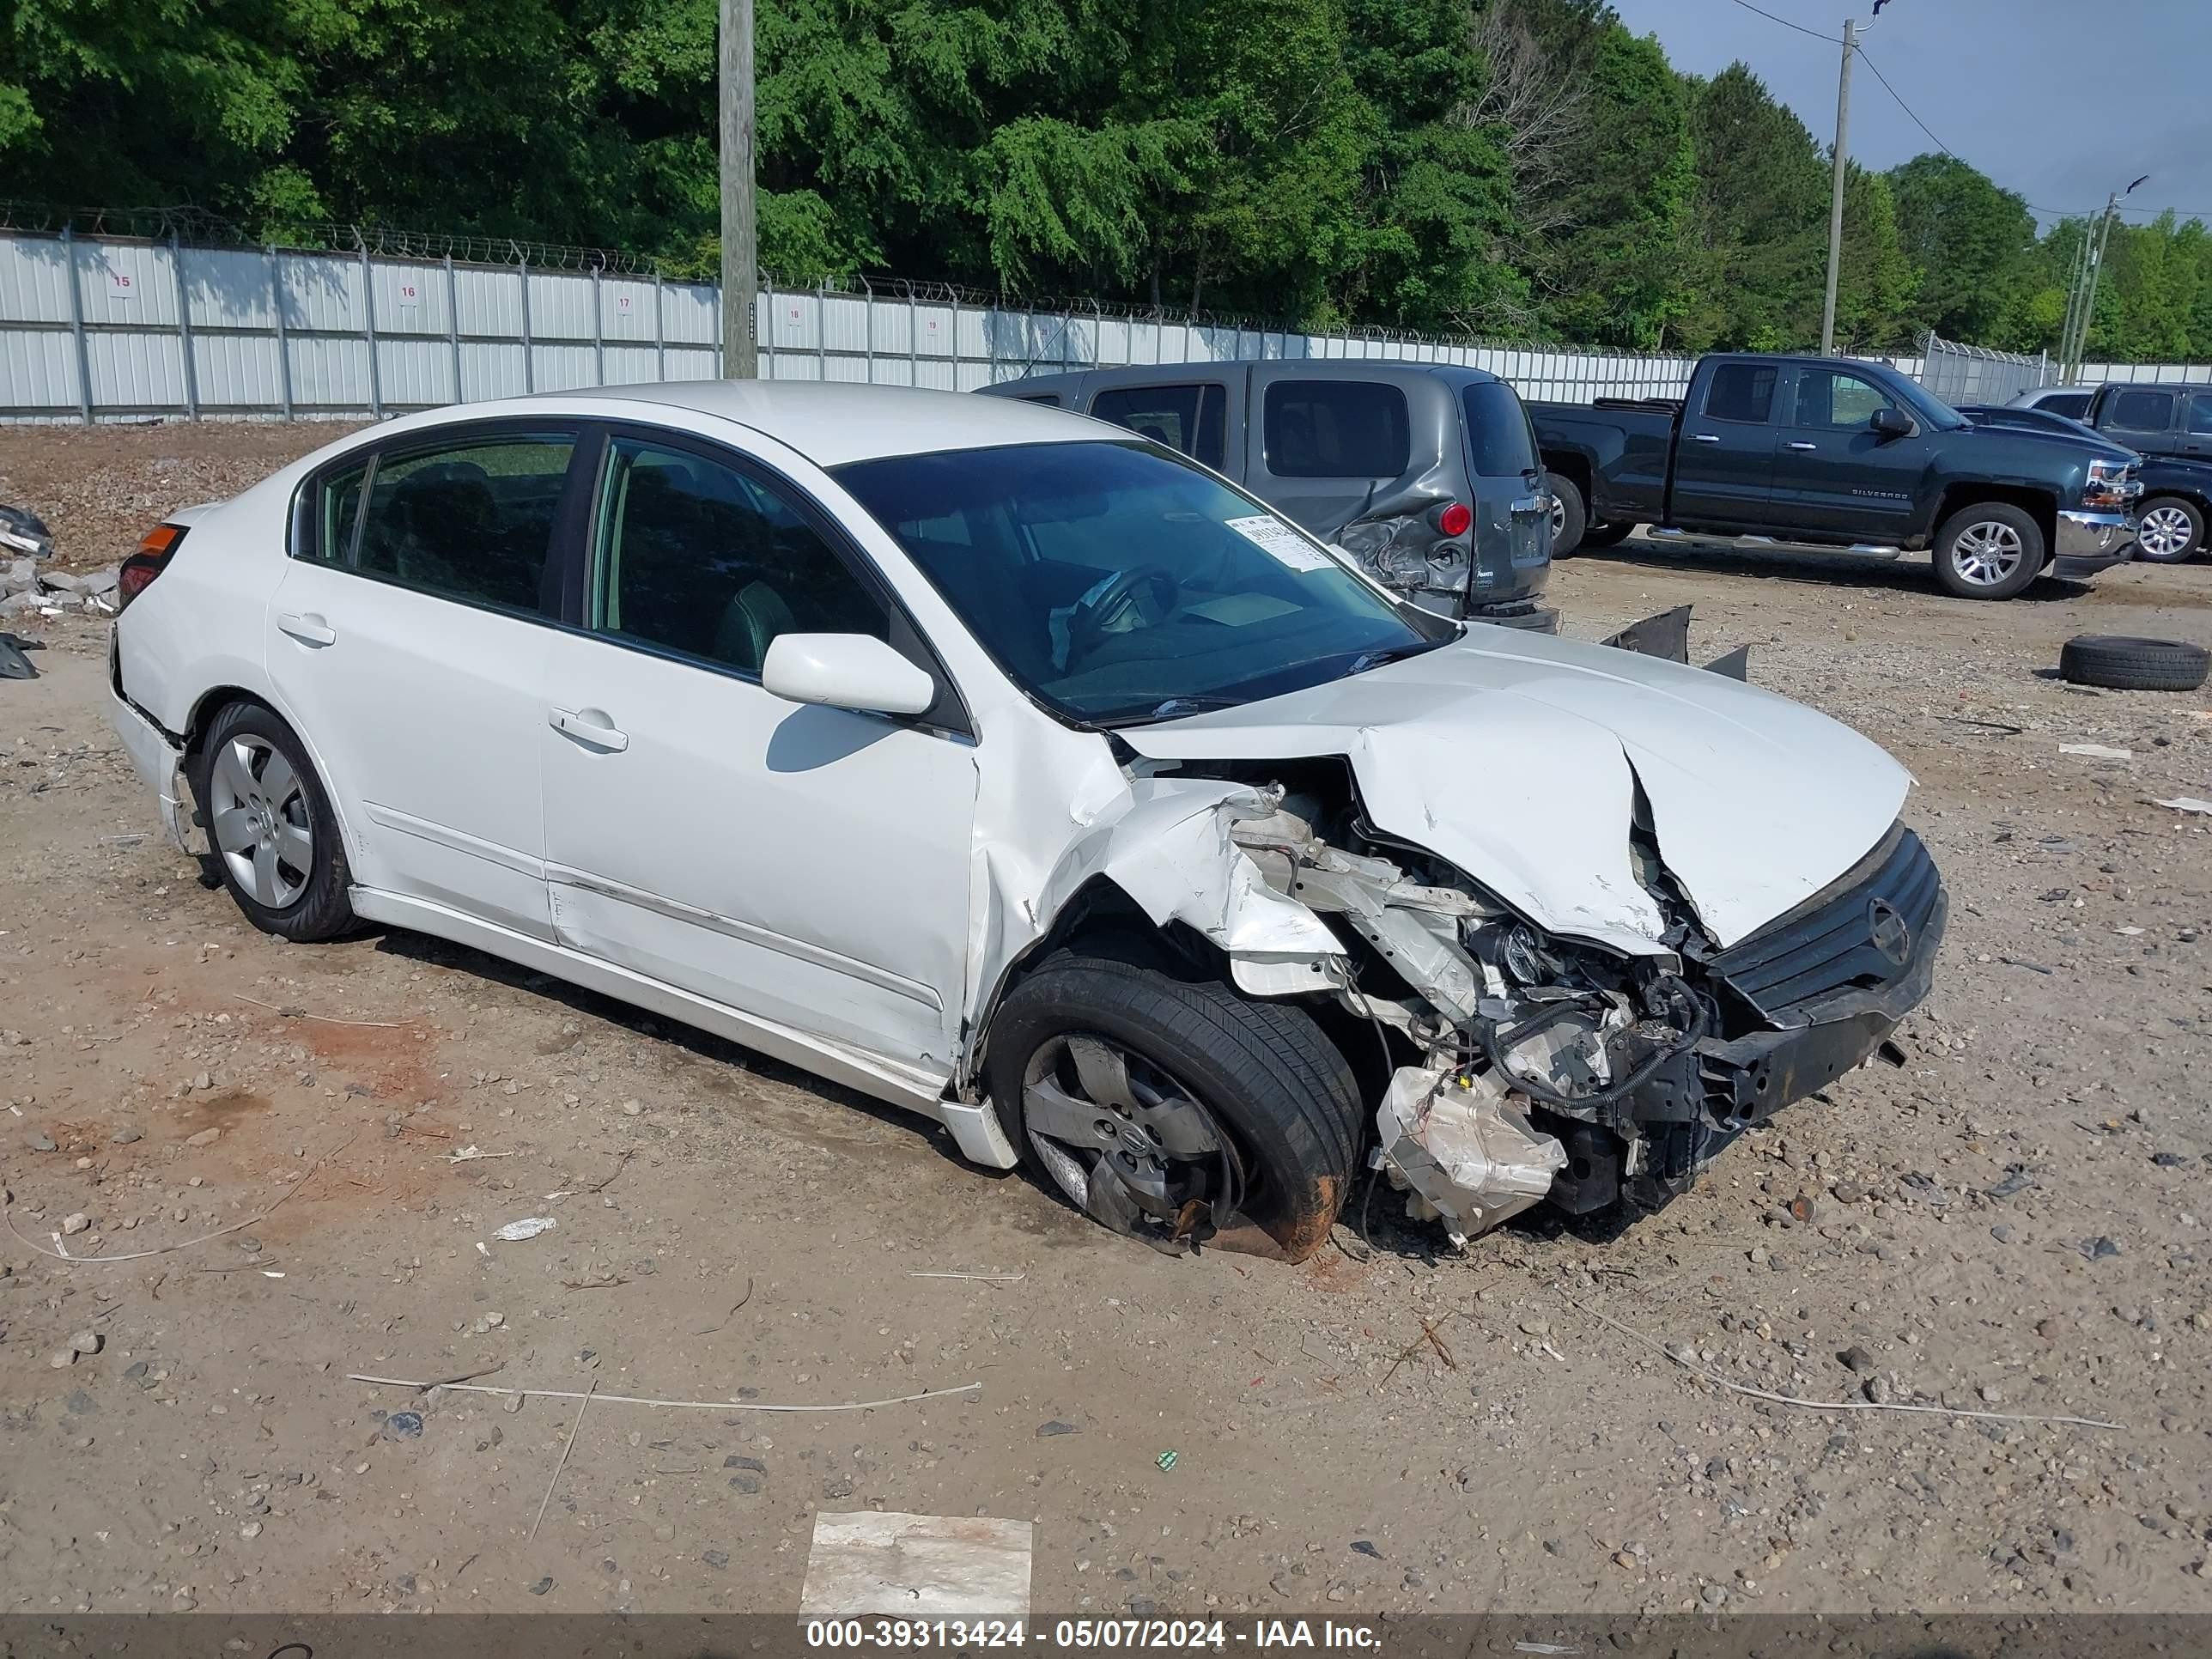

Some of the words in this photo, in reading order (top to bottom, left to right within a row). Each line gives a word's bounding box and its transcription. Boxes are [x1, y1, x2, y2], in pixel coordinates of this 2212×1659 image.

[114, 276, 131, 287] 15
[402, 287, 416, 297] 16
[619, 298, 629, 307] 17
[790, 310, 799, 319] 18
[928, 321, 937, 330] 19
[1851, 489, 1909, 500] SILVERADO
